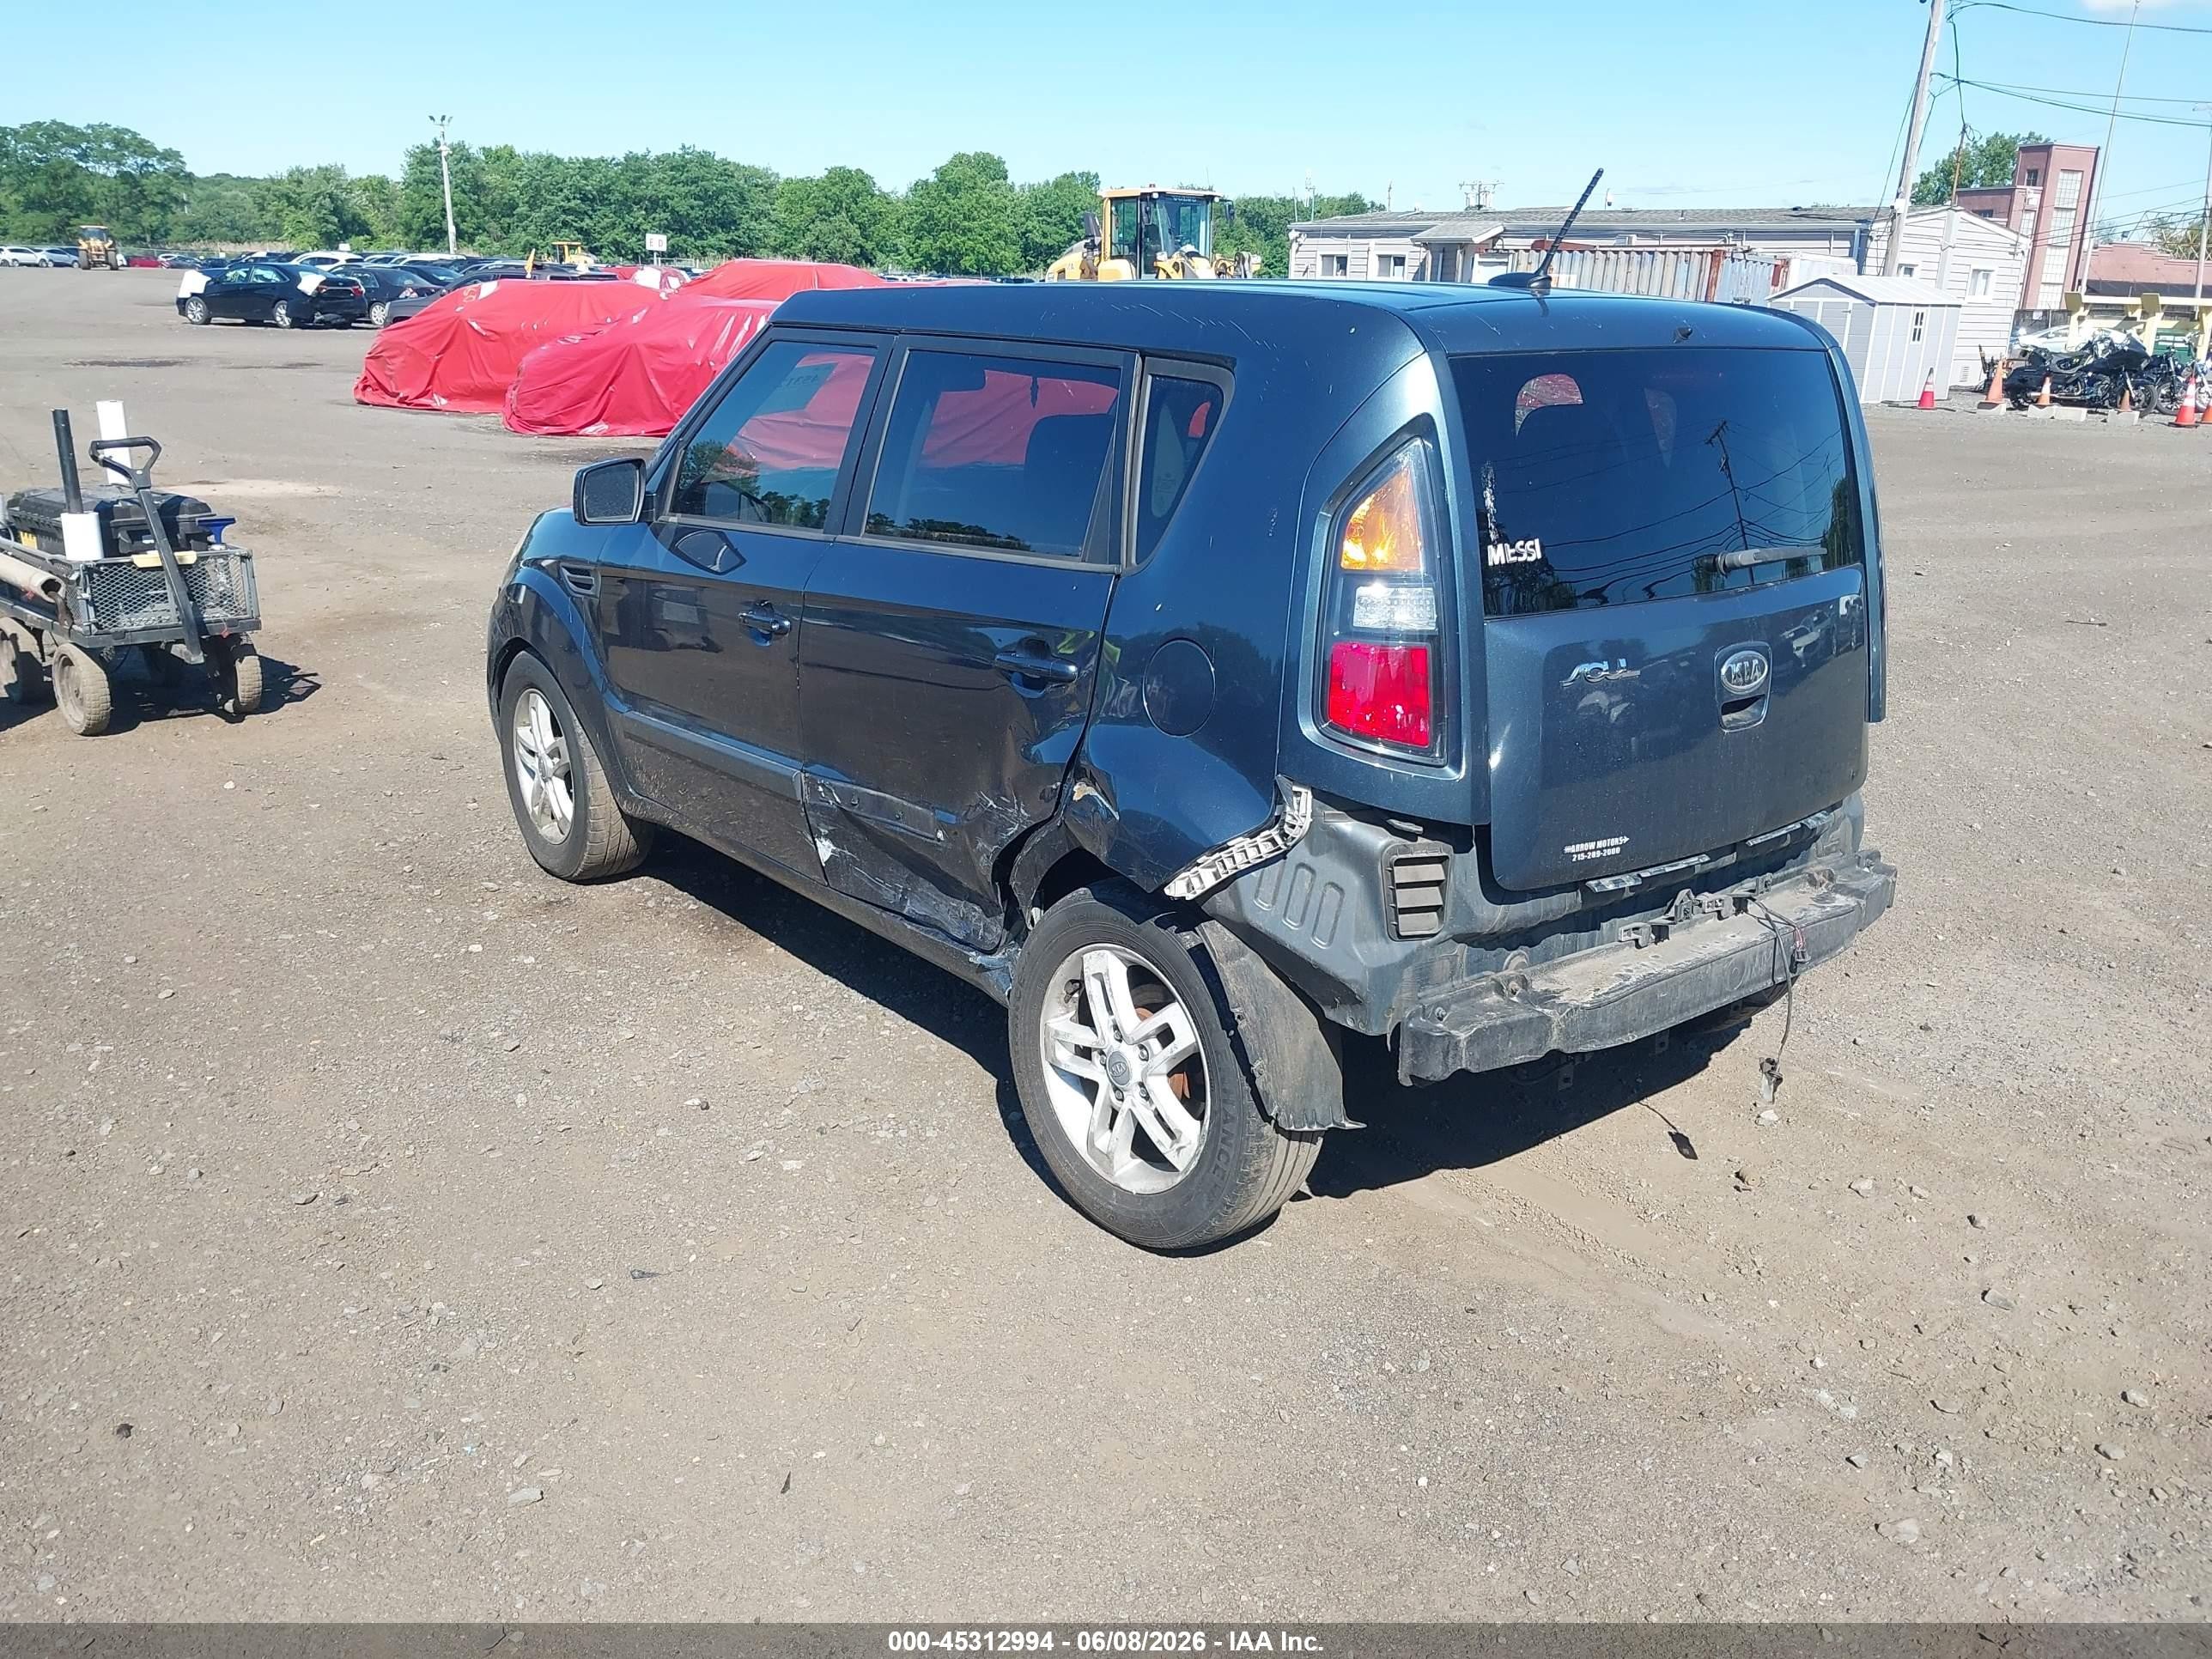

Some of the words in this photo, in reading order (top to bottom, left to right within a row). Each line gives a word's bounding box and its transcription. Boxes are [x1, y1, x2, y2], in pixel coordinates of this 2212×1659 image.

[1487, 538, 1542, 567] MESSI
[1730, 659, 1763, 686] KIA
[1571, 841, 1596, 854] ARROW
[1596, 836, 1626, 850] MOTORS
